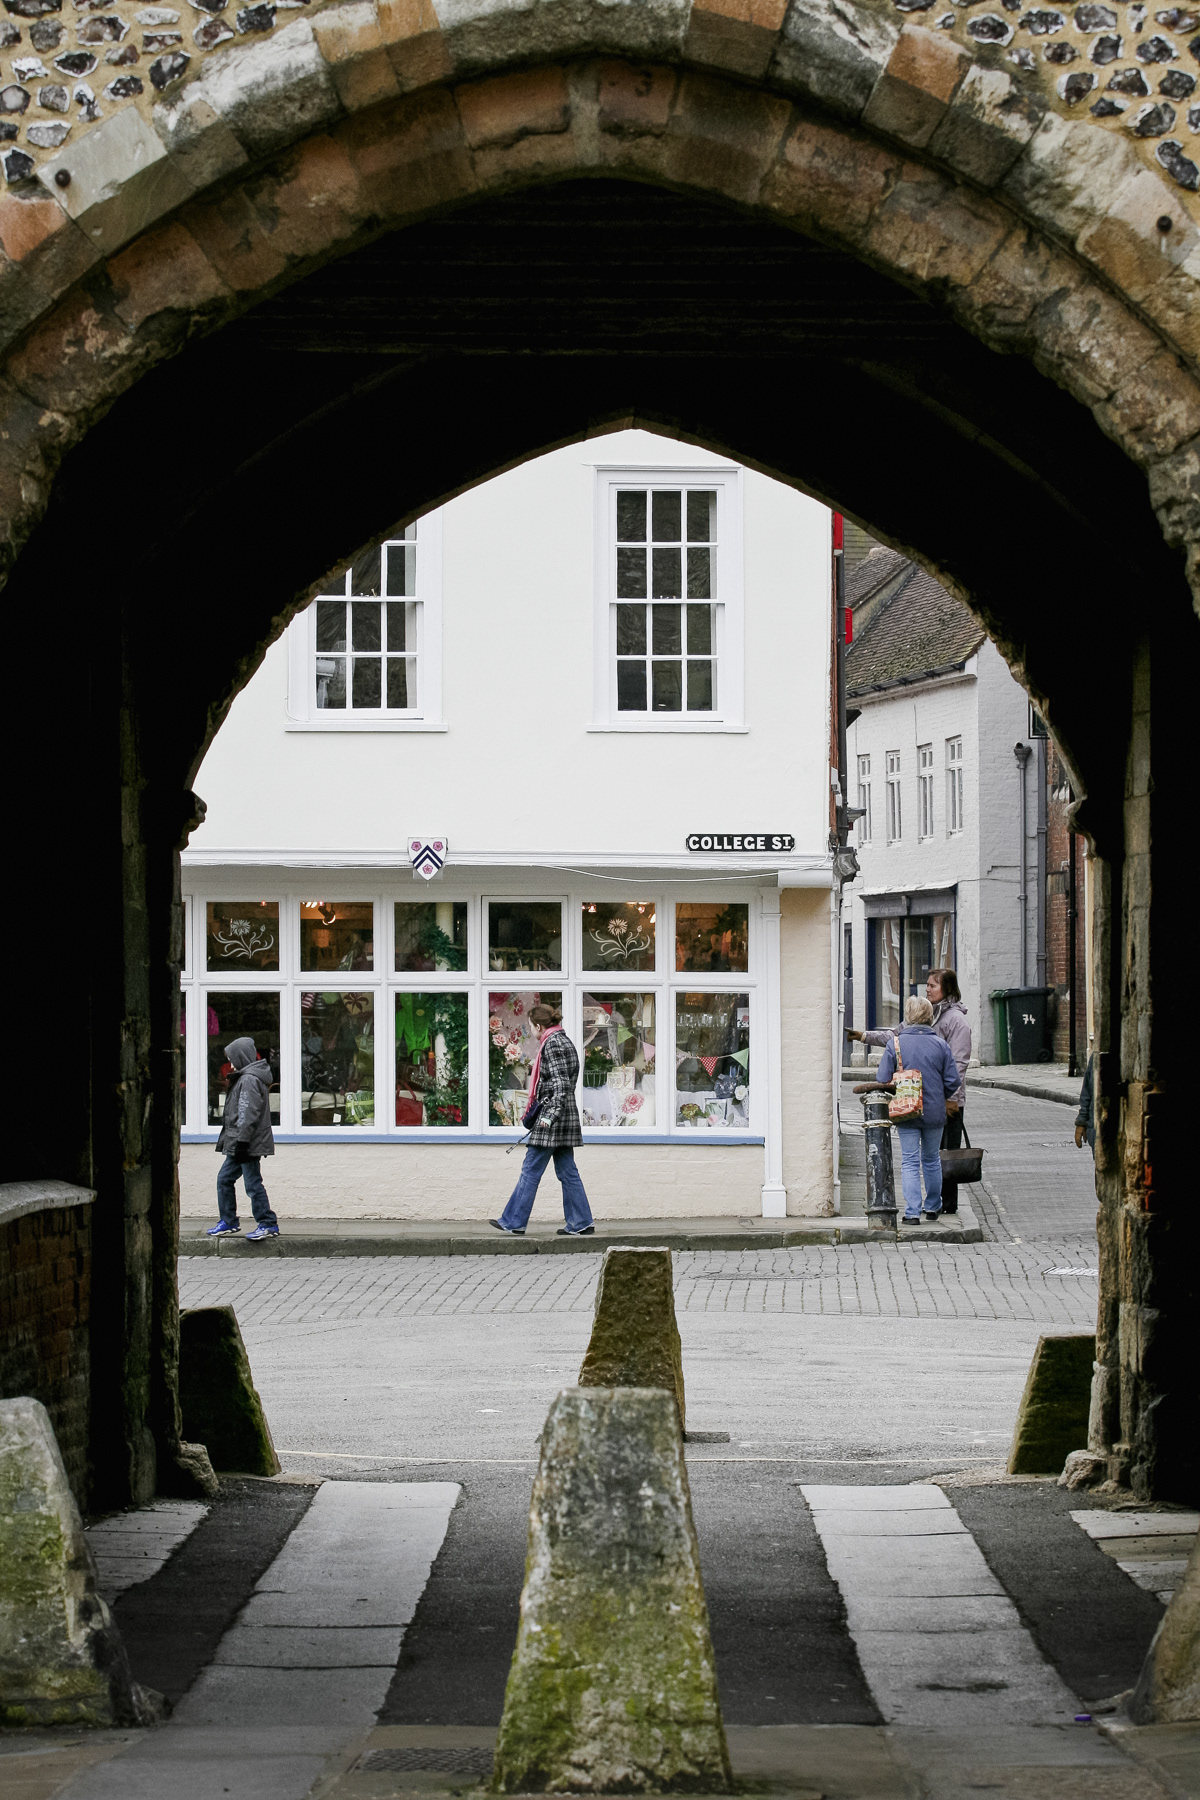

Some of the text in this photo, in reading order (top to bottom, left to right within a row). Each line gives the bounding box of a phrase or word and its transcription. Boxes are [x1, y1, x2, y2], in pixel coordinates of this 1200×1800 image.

[689, 836, 791, 850] COLLEGE ST
[1022, 1013, 1036, 1025] 74
